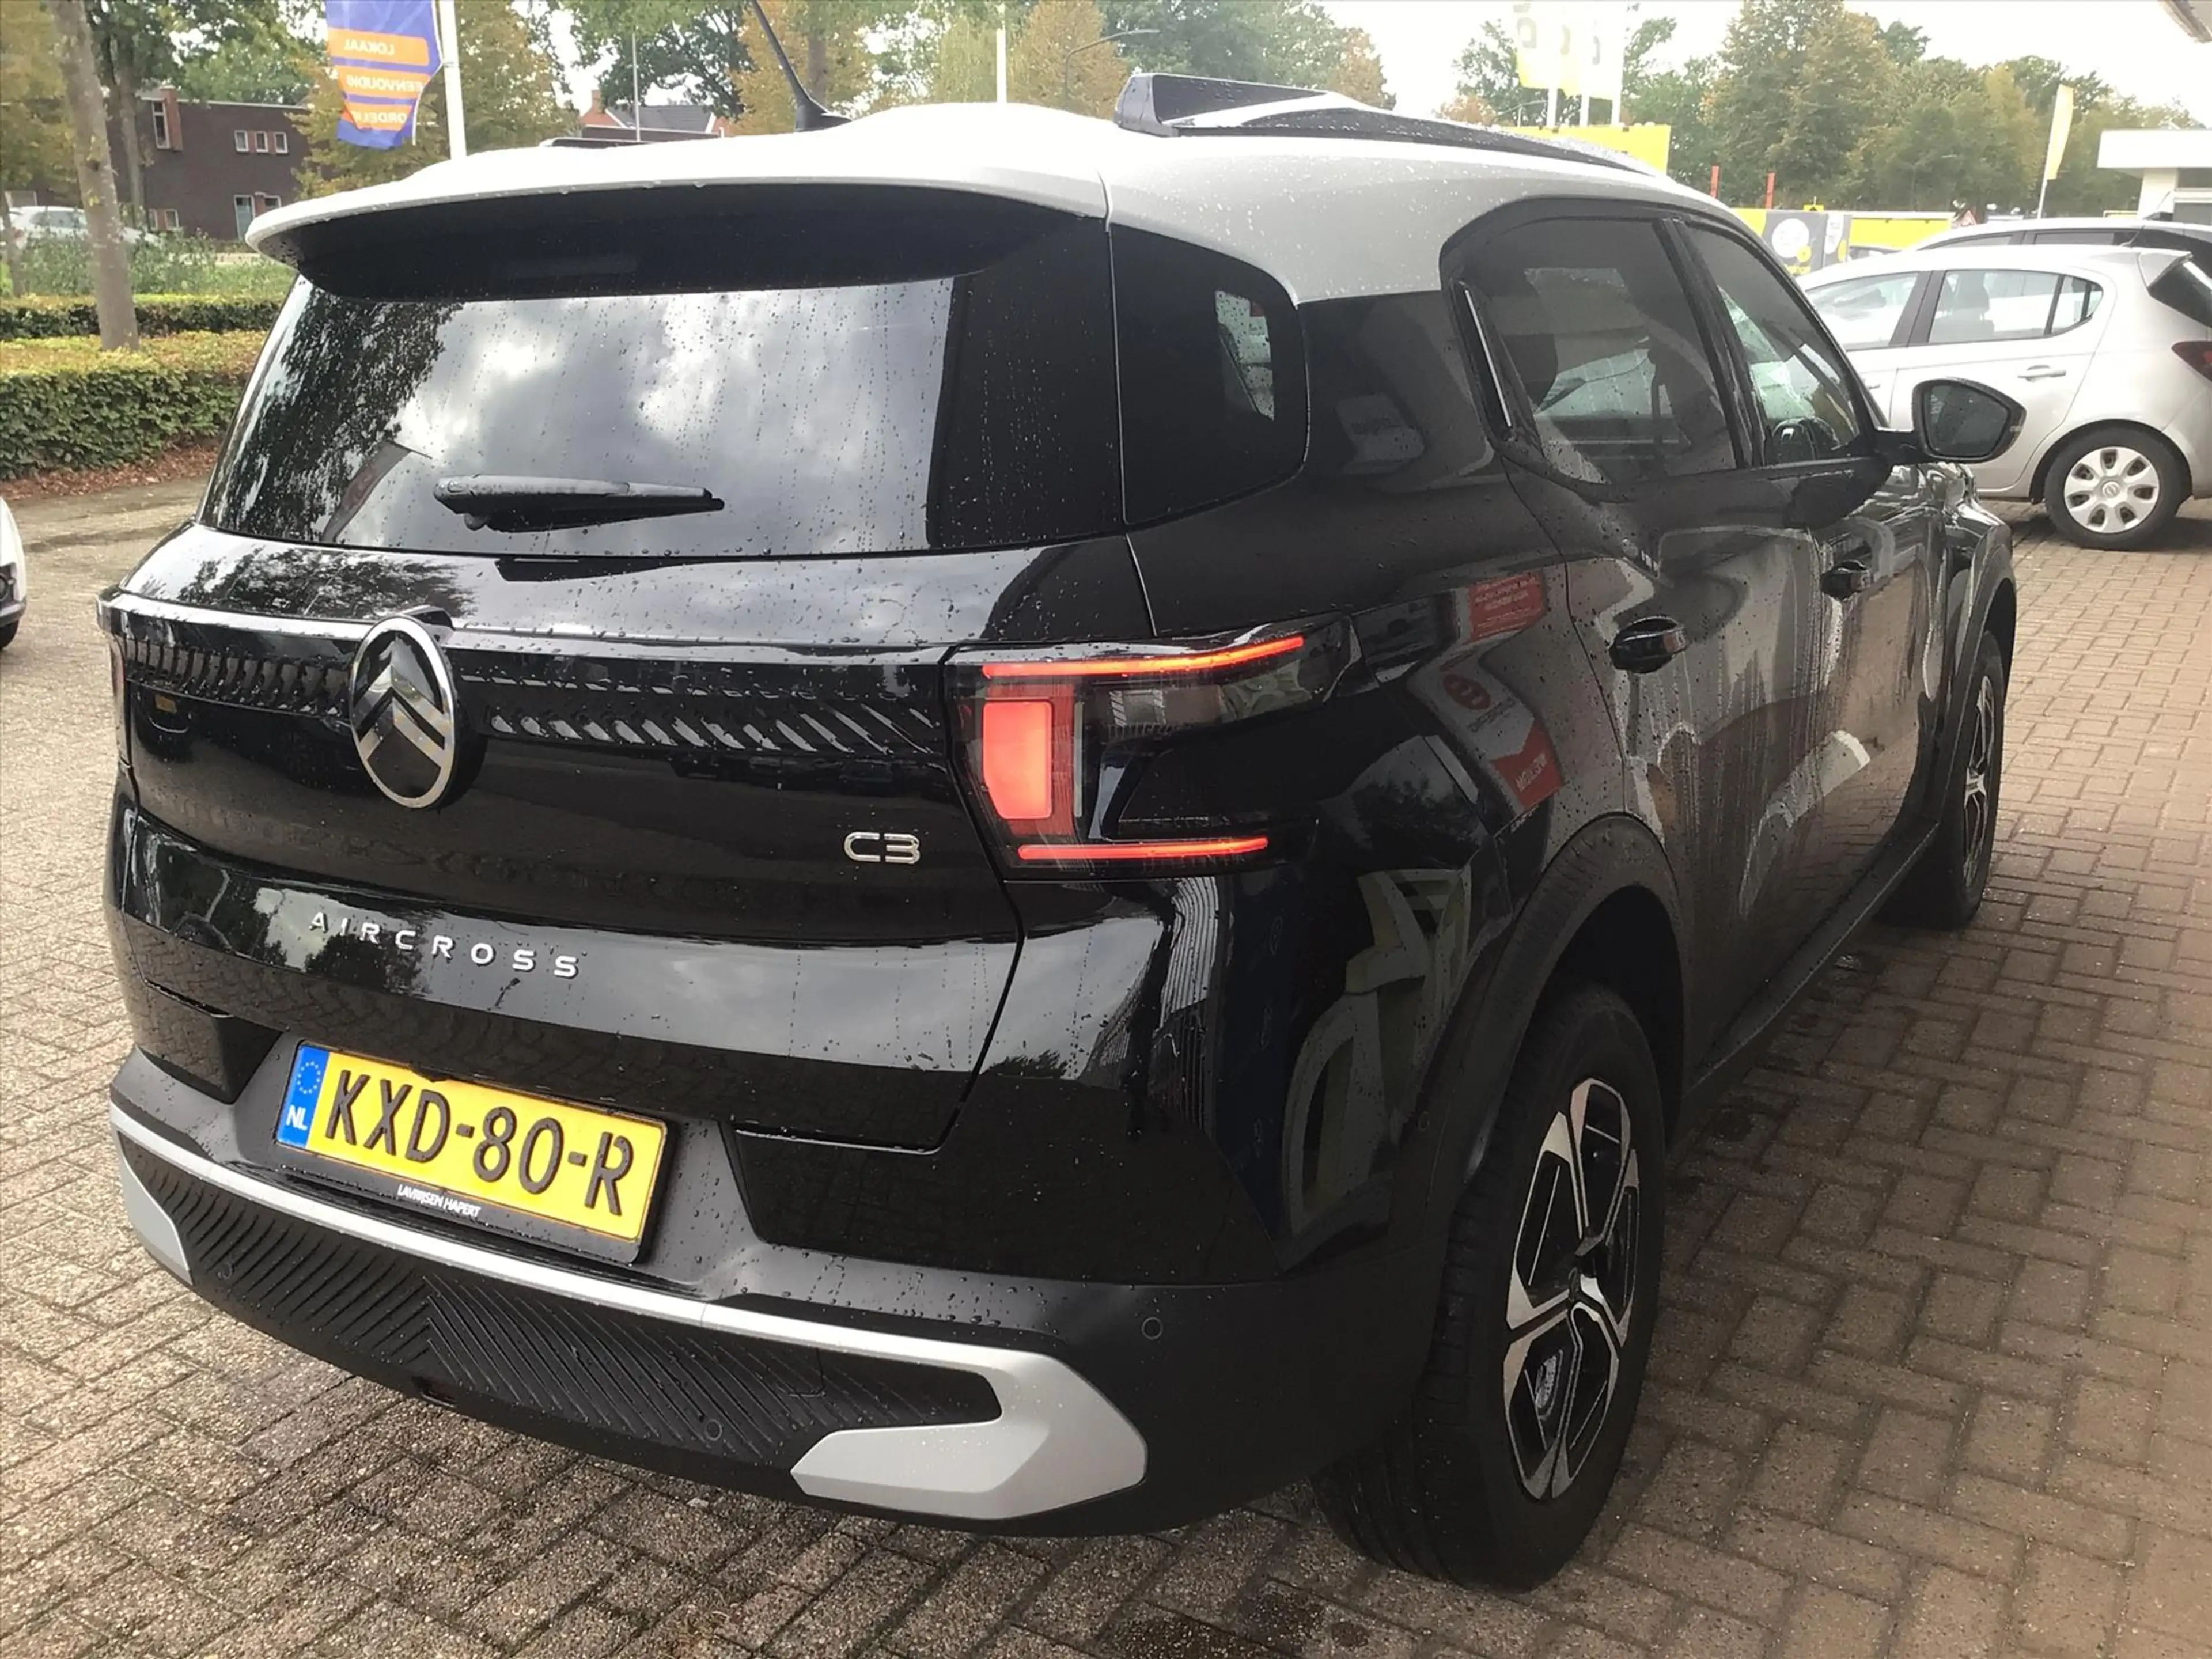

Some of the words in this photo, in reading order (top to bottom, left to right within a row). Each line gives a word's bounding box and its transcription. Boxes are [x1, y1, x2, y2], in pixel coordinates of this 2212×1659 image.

[843, 831, 921, 865] C3
[308, 912, 578, 979] AIRCROSS
[286, 1104, 308, 1131] NL
[324, 1070, 634, 1216] KXD-80-R
[442, 1197, 482, 1218] HAPERT
